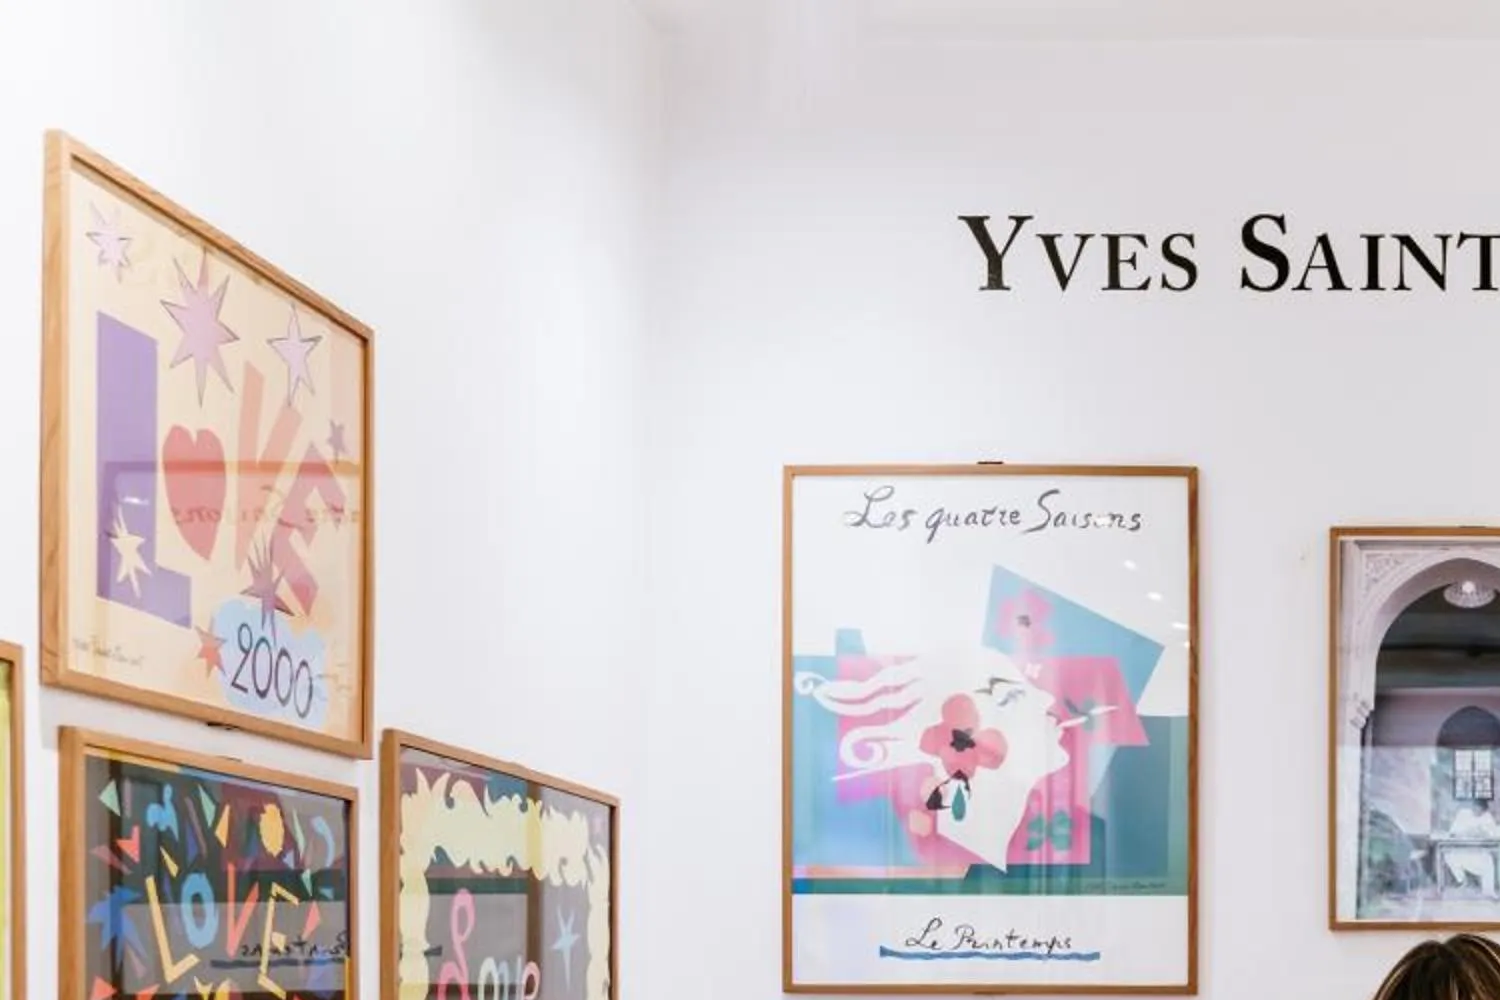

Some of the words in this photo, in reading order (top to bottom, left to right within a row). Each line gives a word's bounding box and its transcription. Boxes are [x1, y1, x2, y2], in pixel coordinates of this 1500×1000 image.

[957, 214, 1197, 293] YVES
[844, 485, 912, 532] Les
[924, 505, 1021, 544] quatre
[231, 623, 313, 719] 2000
[146, 862, 299, 1000] LOVE
[905, 917, 939, 951] Le
